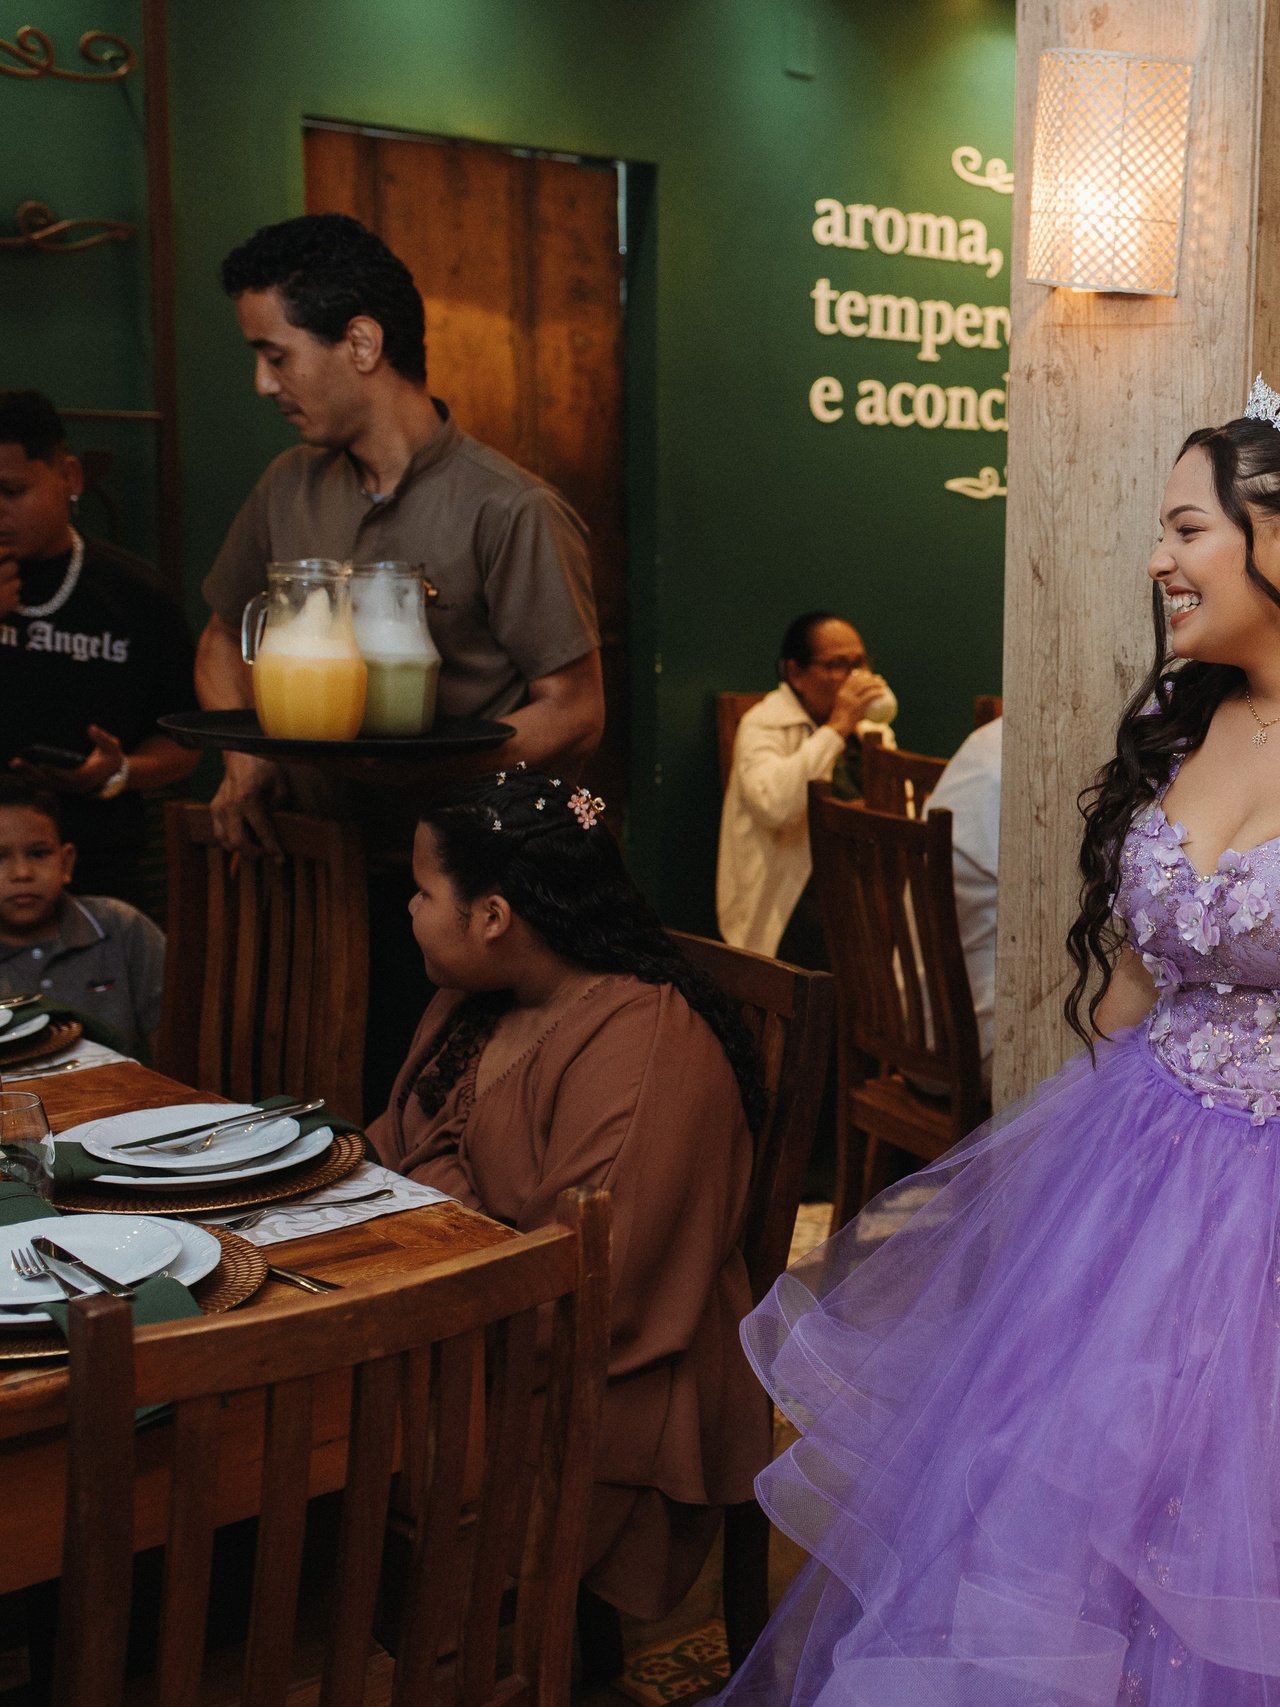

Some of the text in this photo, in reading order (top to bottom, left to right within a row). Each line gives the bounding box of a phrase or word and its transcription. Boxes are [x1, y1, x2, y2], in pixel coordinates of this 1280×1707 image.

[812, 198, 1003, 278] aroma,
[810, 278, 1011, 362] temper
[809, 376, 844, 423] e
[26, 620, 131, 663] Angels
